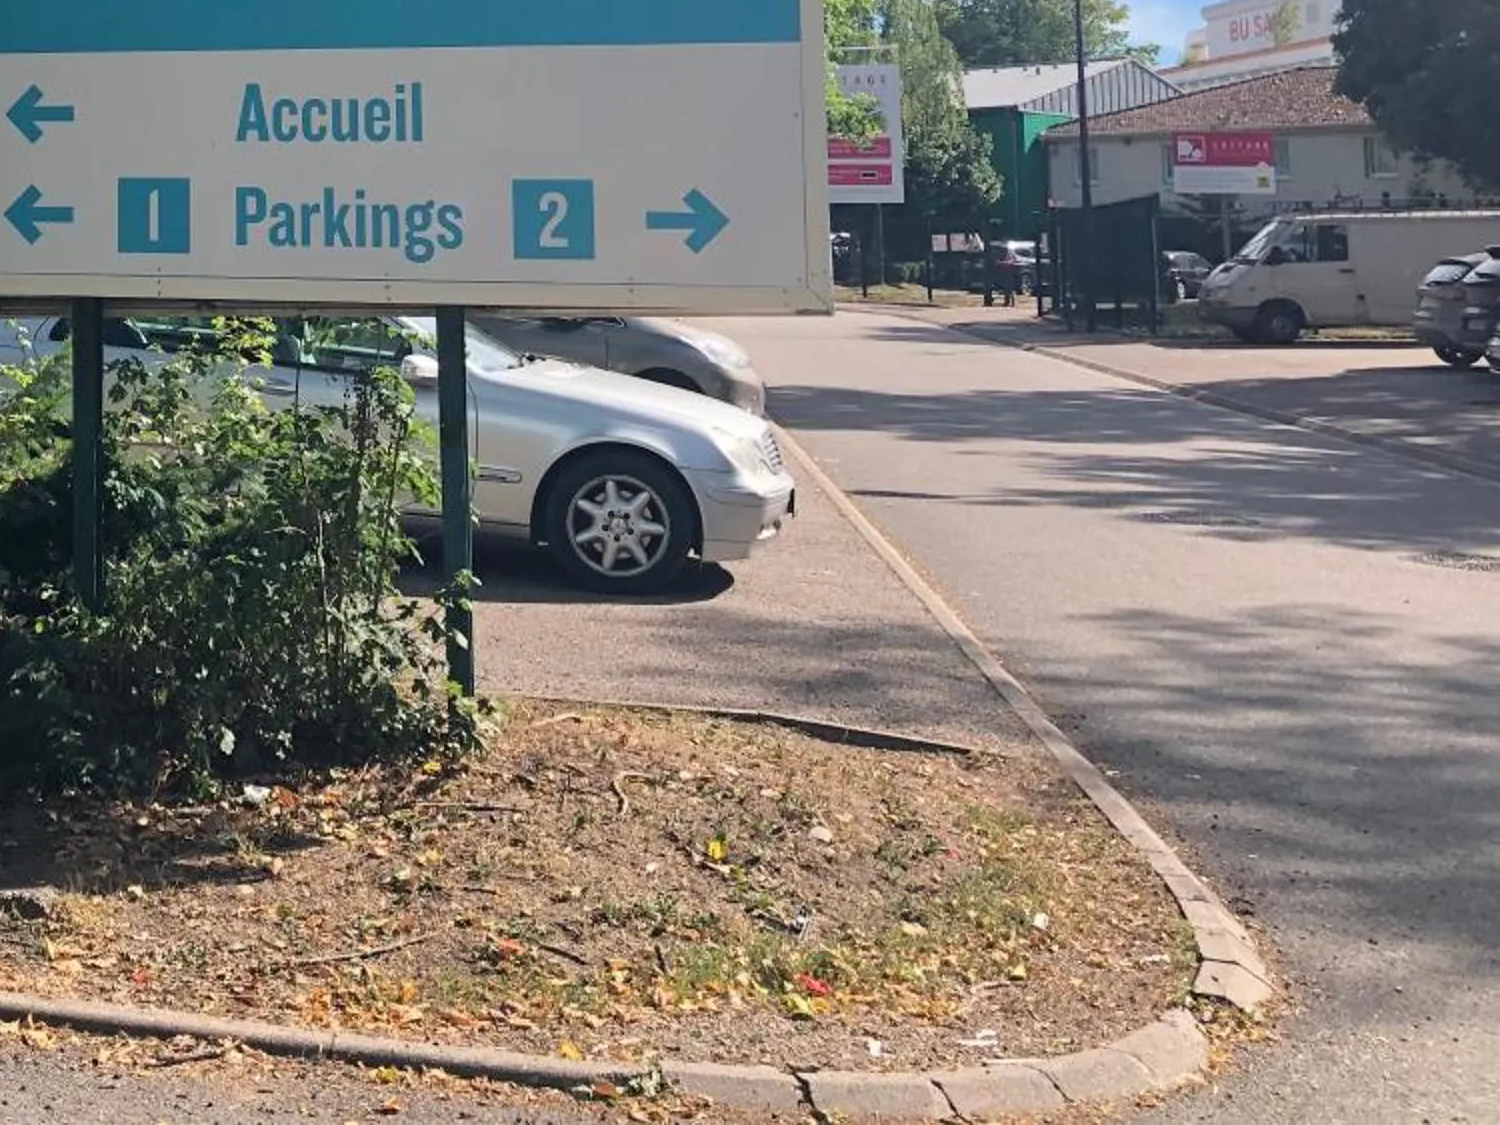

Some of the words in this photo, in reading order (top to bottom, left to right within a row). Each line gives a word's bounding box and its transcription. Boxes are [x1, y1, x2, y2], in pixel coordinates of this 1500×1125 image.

[236, 82, 423, 143] Accueil
[147, 188, 161, 243] 1
[235, 187, 464, 263] Parkings
[538, 191, 569, 247] 2
